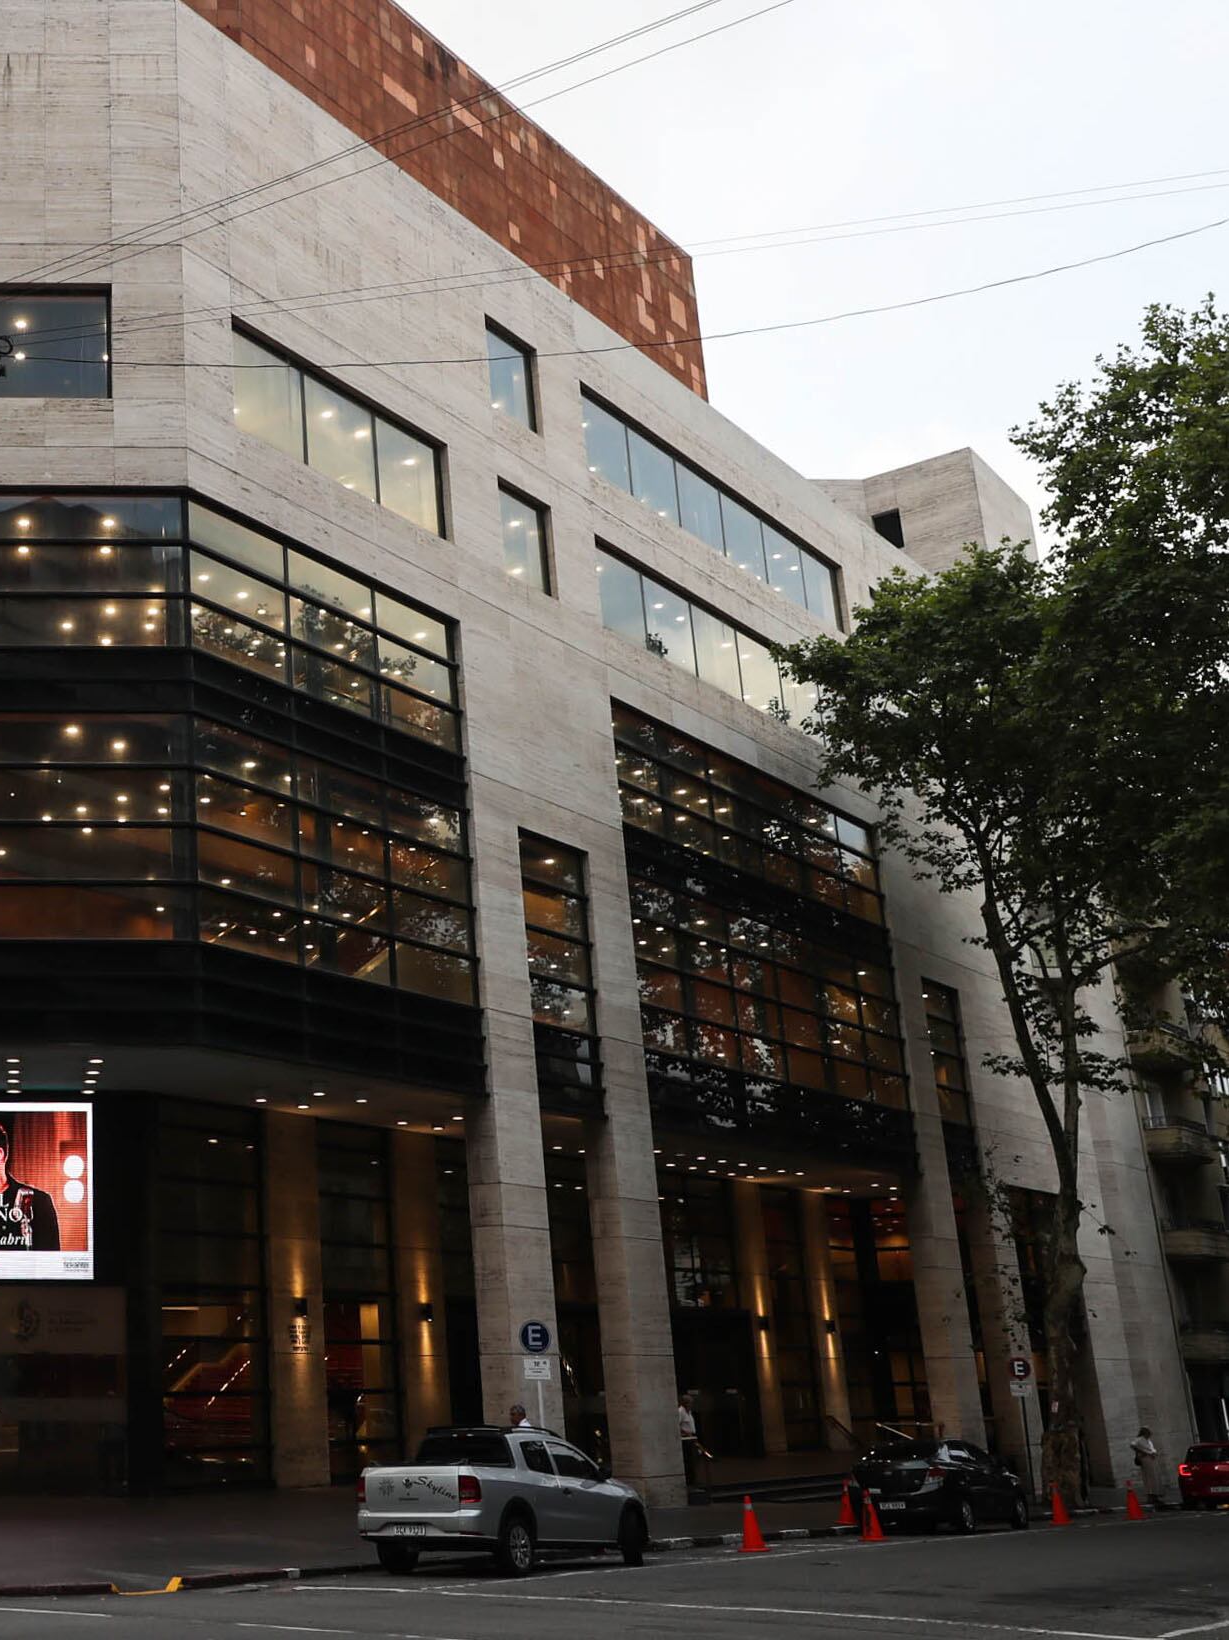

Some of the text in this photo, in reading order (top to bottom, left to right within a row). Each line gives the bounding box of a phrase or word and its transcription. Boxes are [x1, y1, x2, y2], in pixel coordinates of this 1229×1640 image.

[528, 1325, 542, 1345] E
[1014, 1361, 1025, 1375] E
[413, 1476, 457, 1499] Skyline
